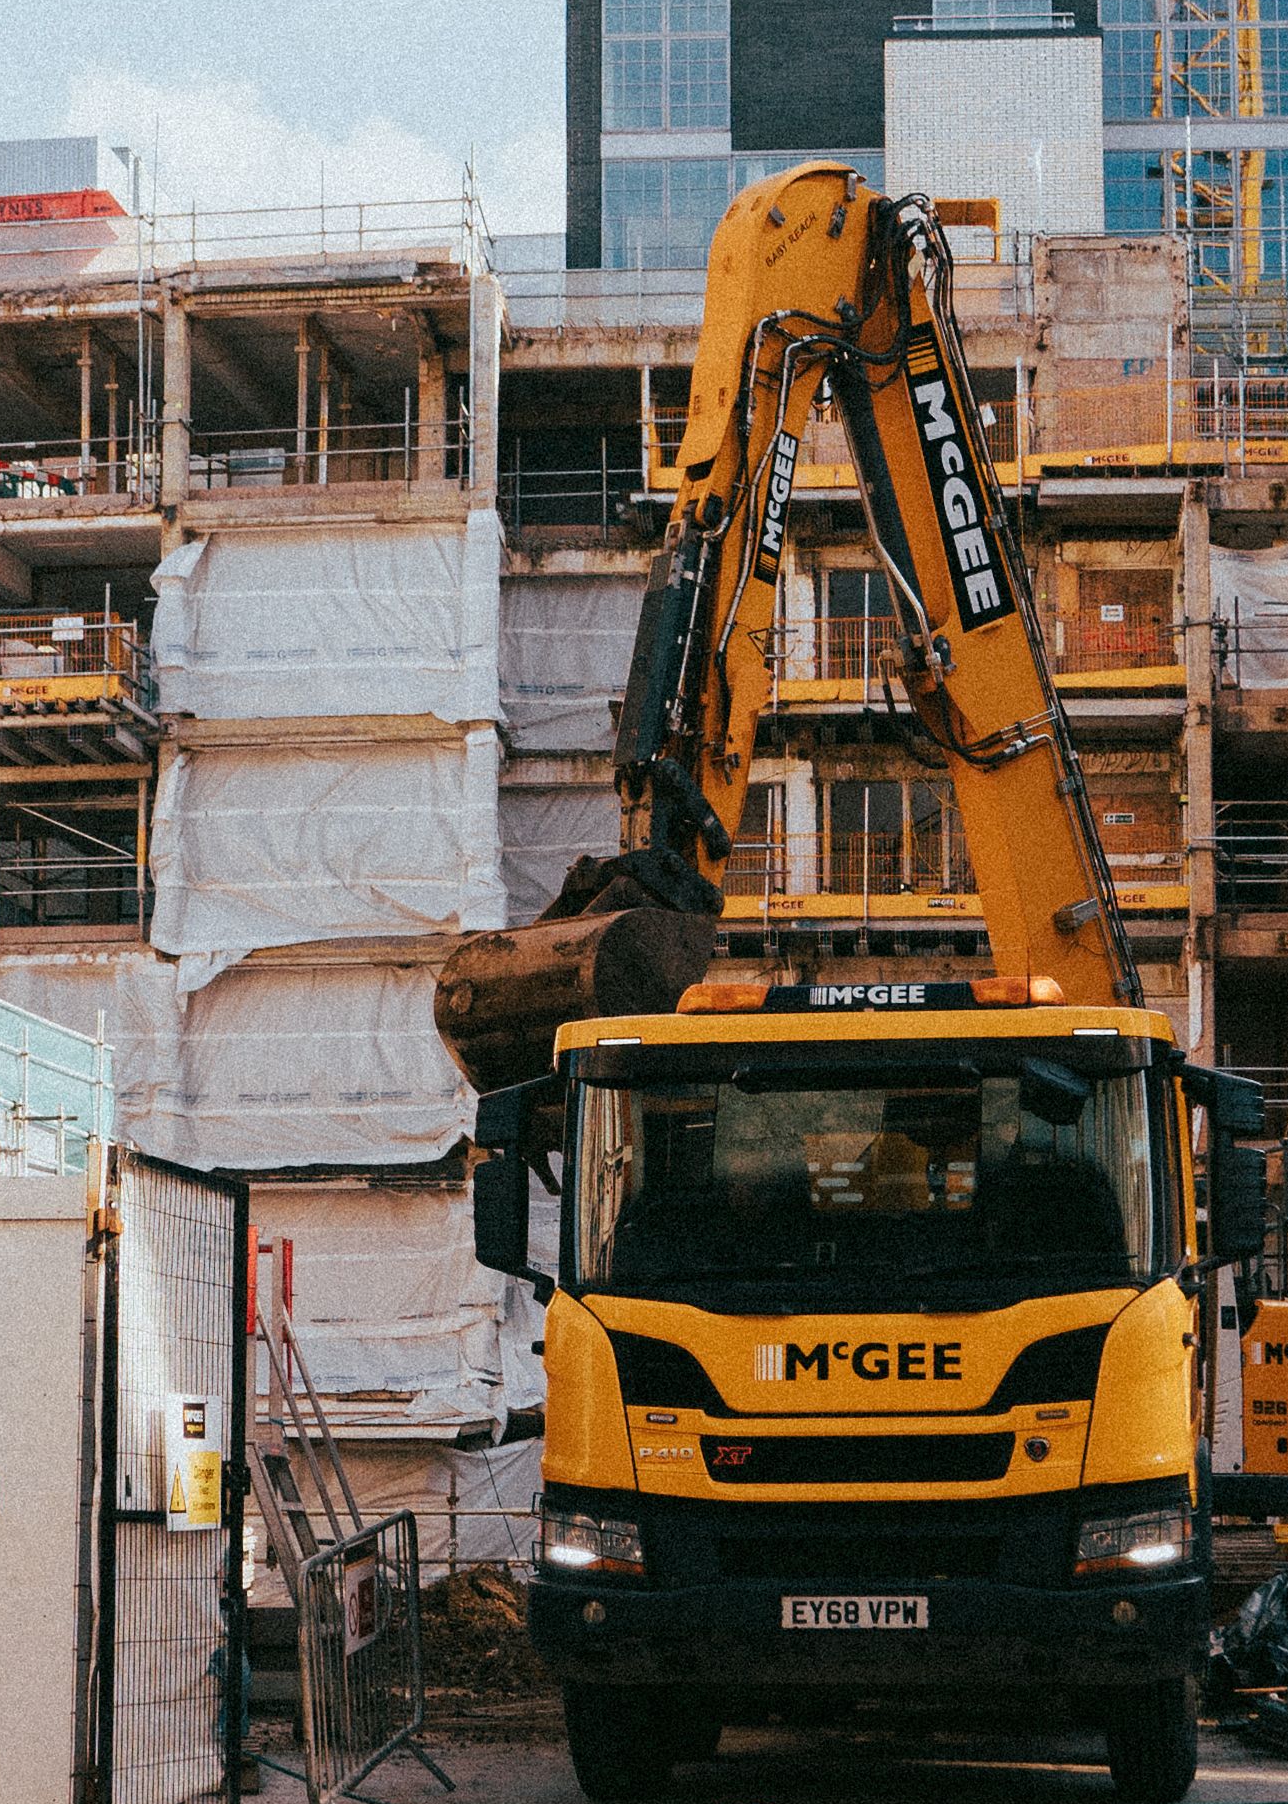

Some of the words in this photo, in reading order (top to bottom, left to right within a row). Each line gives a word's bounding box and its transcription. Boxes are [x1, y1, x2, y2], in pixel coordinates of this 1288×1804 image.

[788, 210, 817, 245] REACH
[786, 1341, 962, 1381] McGEE
[1252, 1399, 1287, 1415] 926
[639, 1447, 653, 1458] P
[656, 1447, 695, 1460] 410
[713, 1445, 752, 1465] XT
[791, 1600, 859, 1625] EY68
[868, 1600, 919, 1625] VPW
